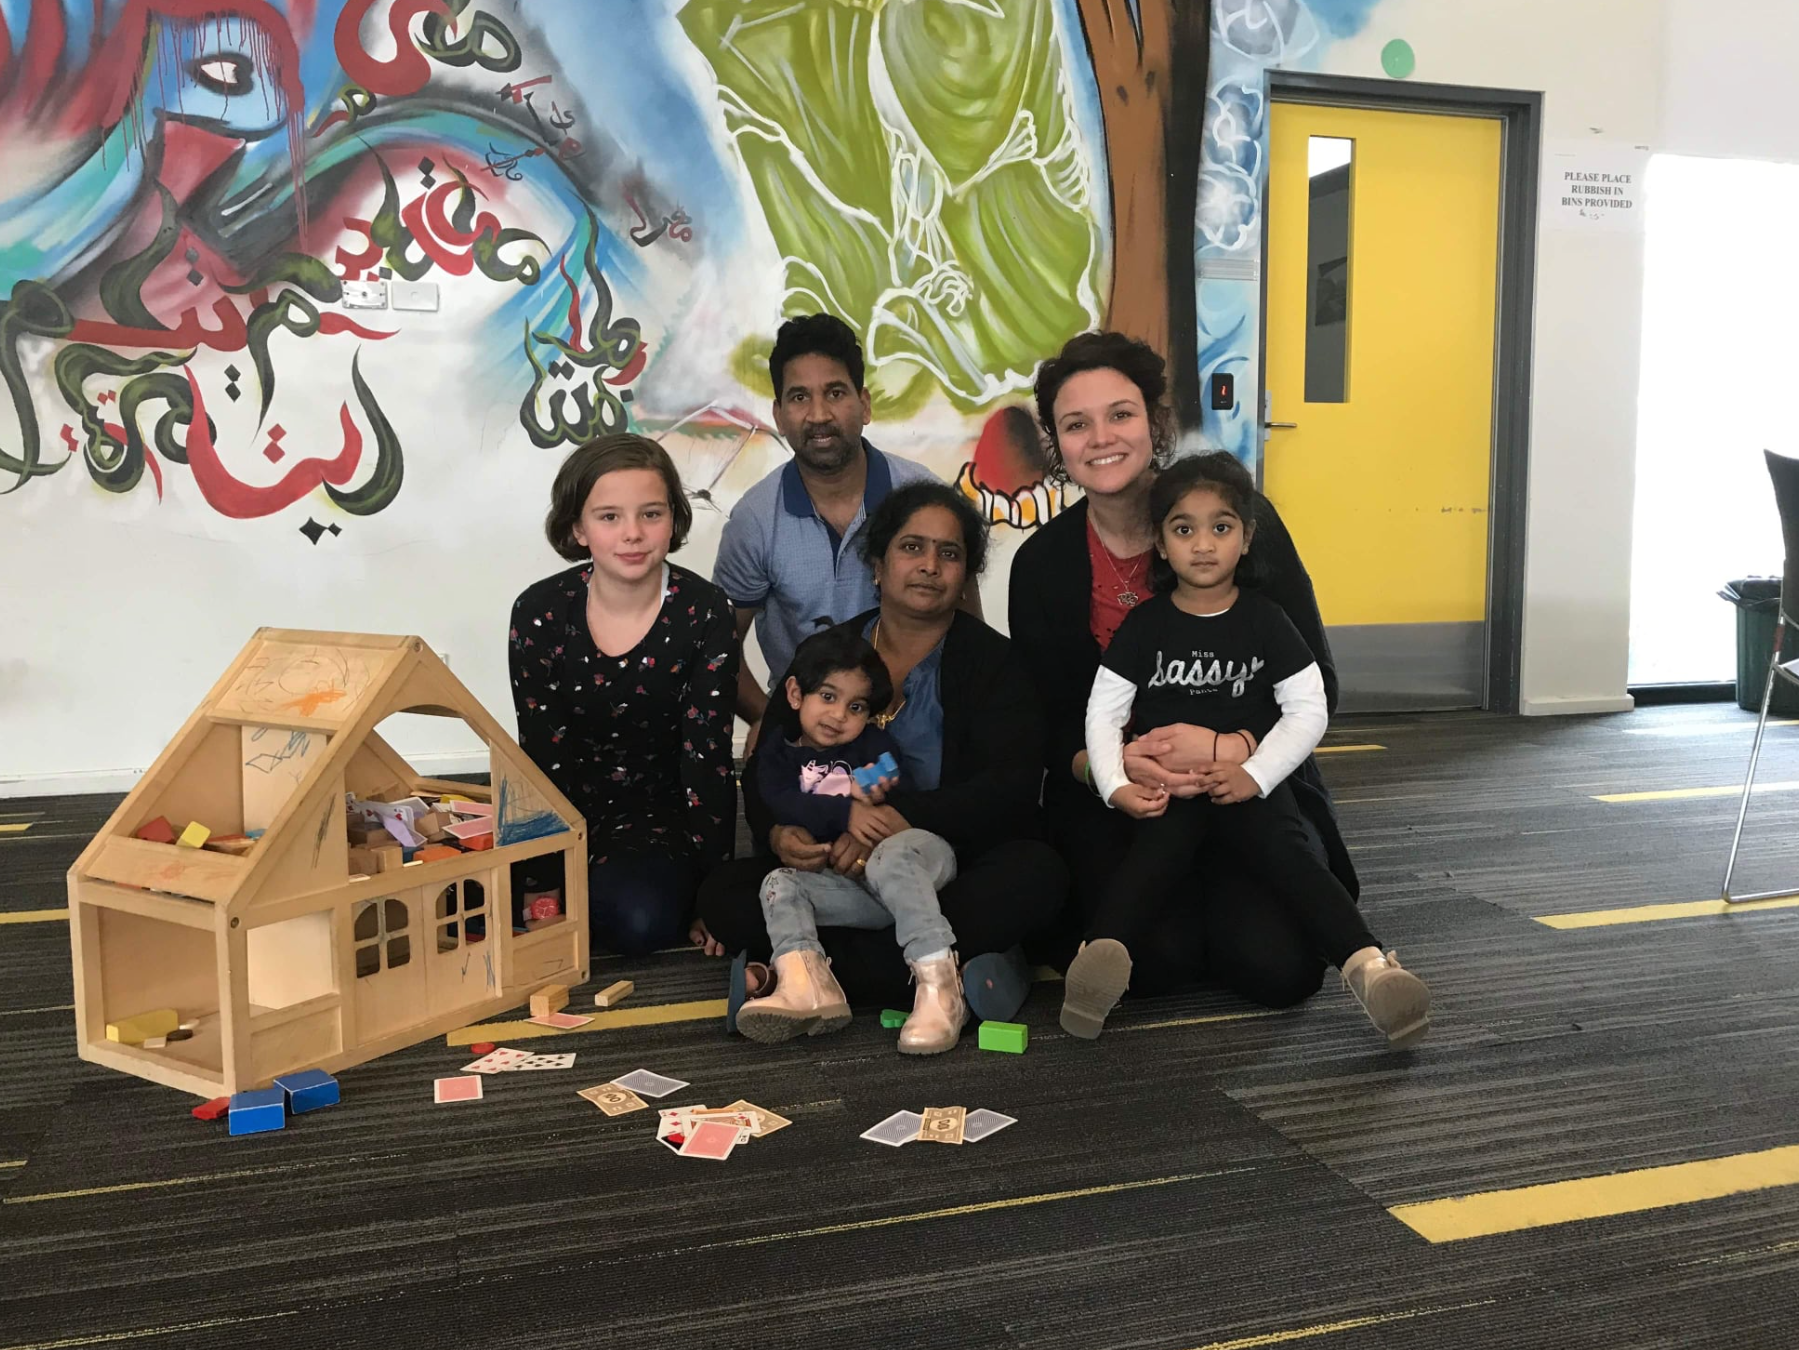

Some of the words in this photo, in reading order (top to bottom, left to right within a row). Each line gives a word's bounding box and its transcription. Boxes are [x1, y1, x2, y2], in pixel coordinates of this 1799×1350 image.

[1564, 171, 1600, 182] PLEASE
[1601, 173, 1632, 184] PLACE
[1571, 184, 1612, 196] RUBBISH
[1613, 186, 1624, 196] IN
[1561, 196, 1583, 207] BINS
[1584, 198, 1633, 209] PROVIDED
[1191, 650, 1215, 658] Miss
